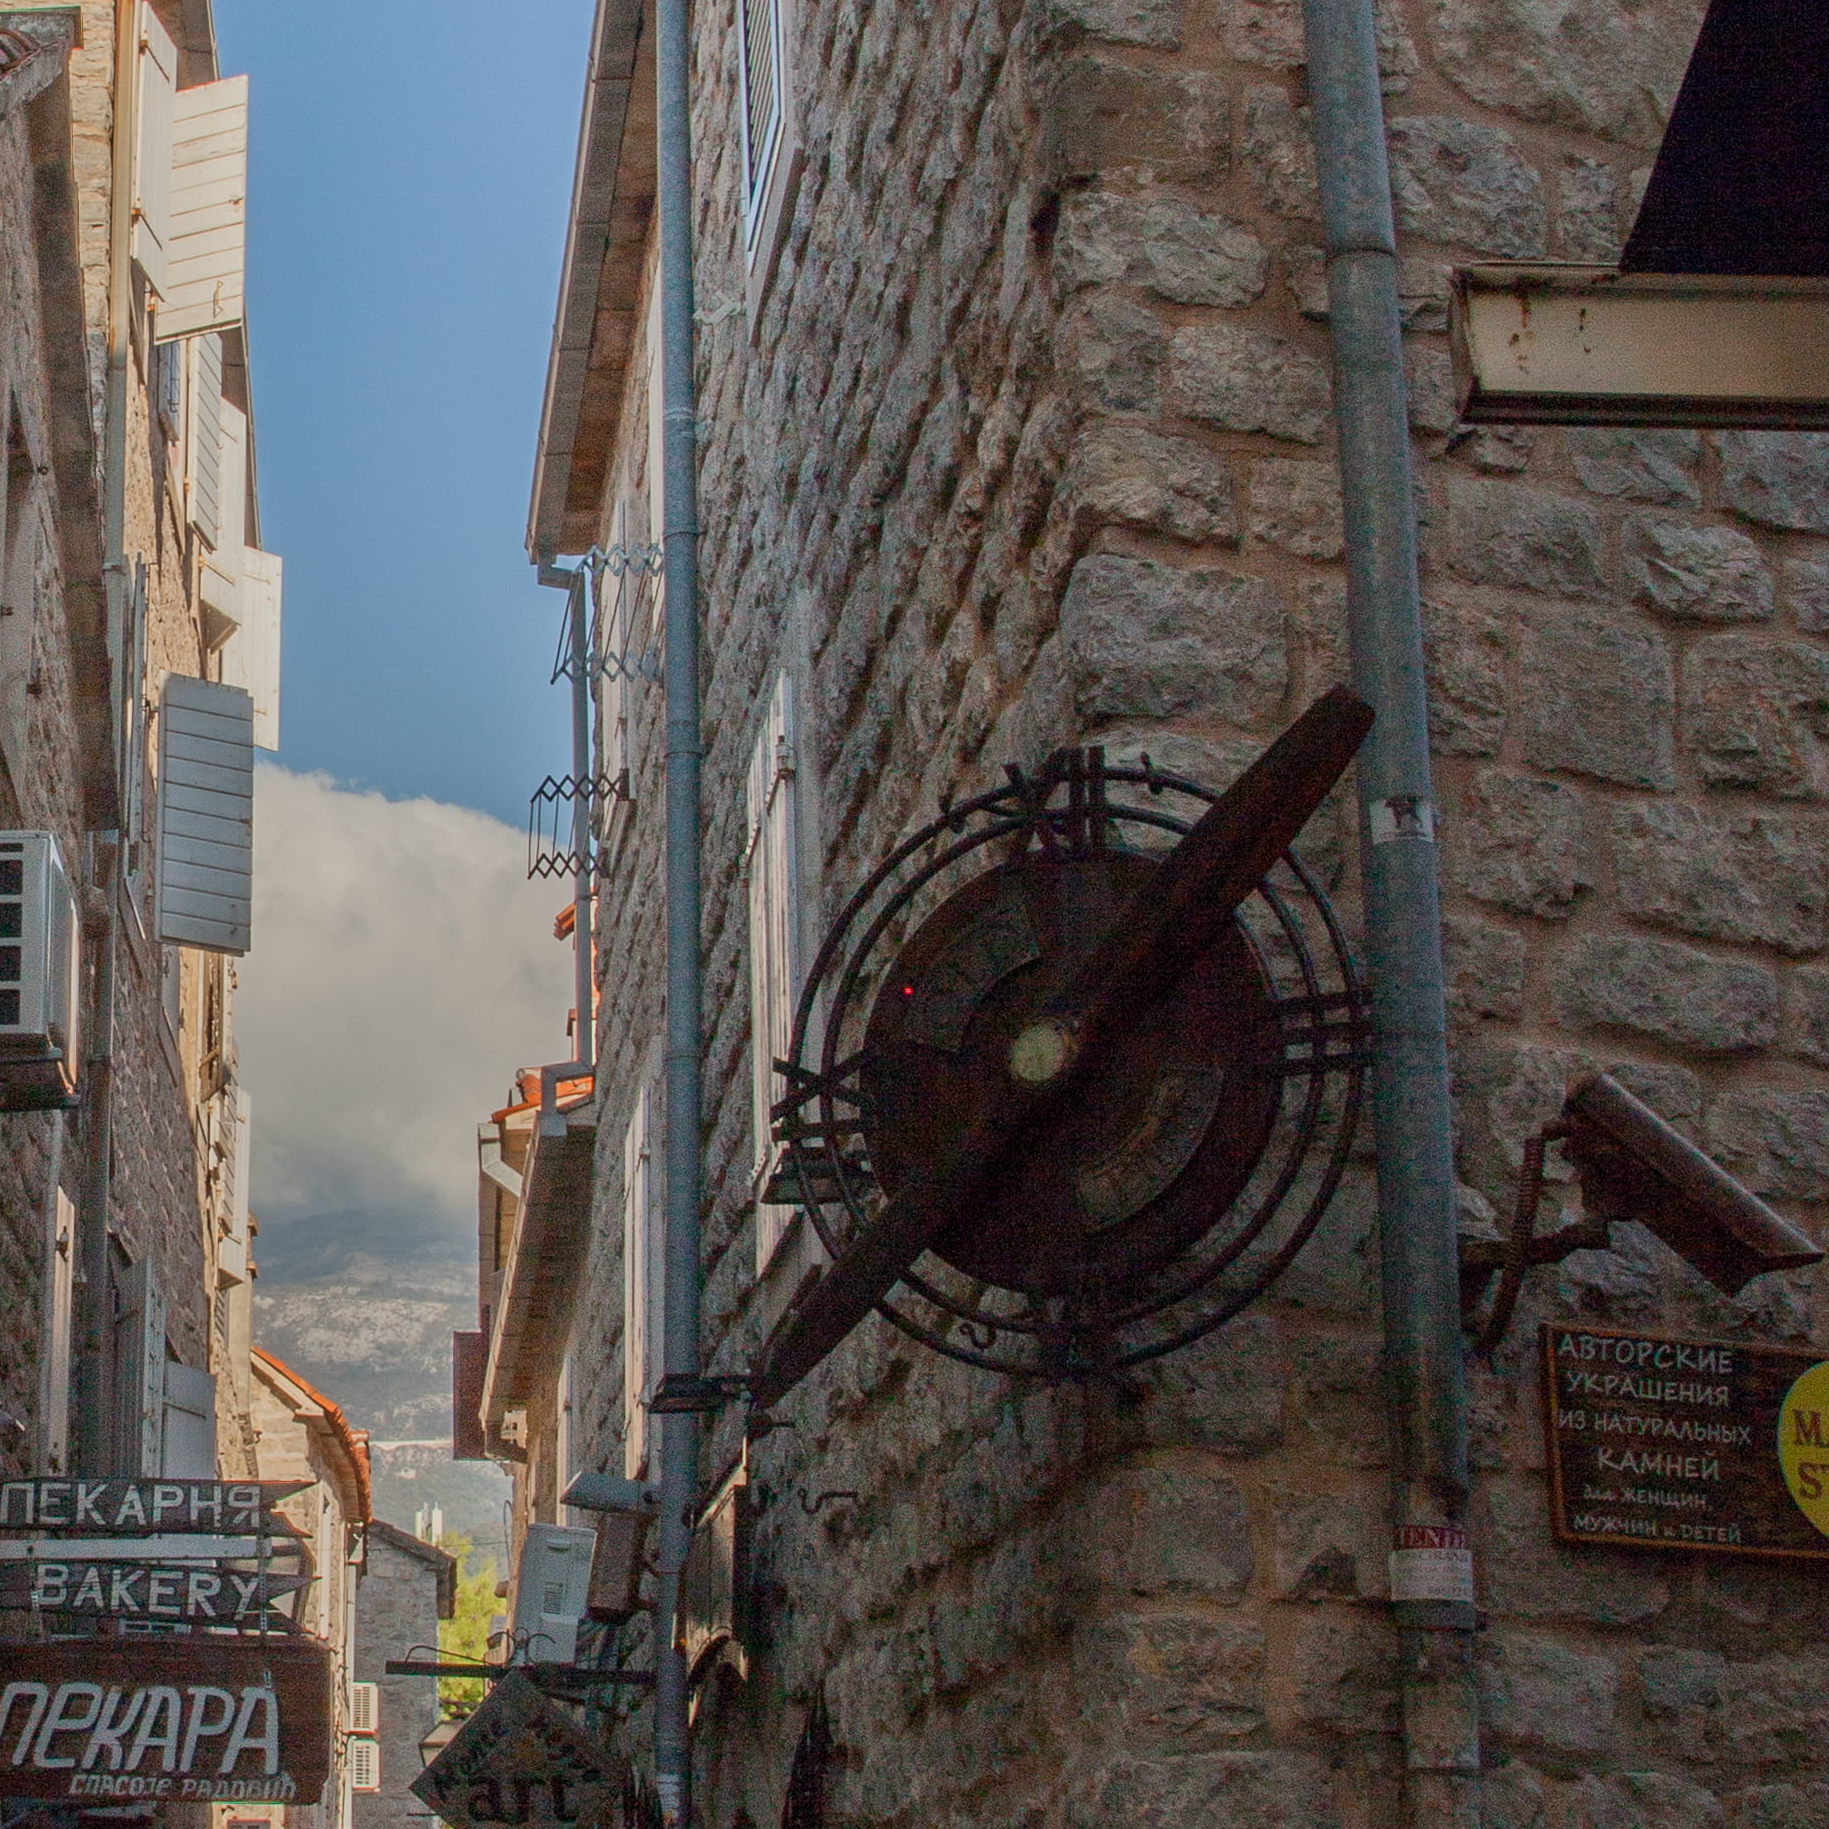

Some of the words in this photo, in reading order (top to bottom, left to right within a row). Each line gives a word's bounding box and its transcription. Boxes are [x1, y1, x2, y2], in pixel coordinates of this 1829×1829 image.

[1558, 1332, 1734, 1375] АВТОРСКИЕ
[1565, 1370, 1730, 1407] УКРАШЕНИЯ
[1557, 1408, 1586, 1431] ИЗ
[1593, 1411, 1752, 1446] НАТУРАЛЬНЫХ
[1597, 1445, 1721, 1481] КАМНЕЙ
[0, 1481, 261, 1528] ПЕКАРНЯ
[1573, 1514, 1658, 1537] МУЖЧИН
[35, 1563, 261, 1620] BAKERY
